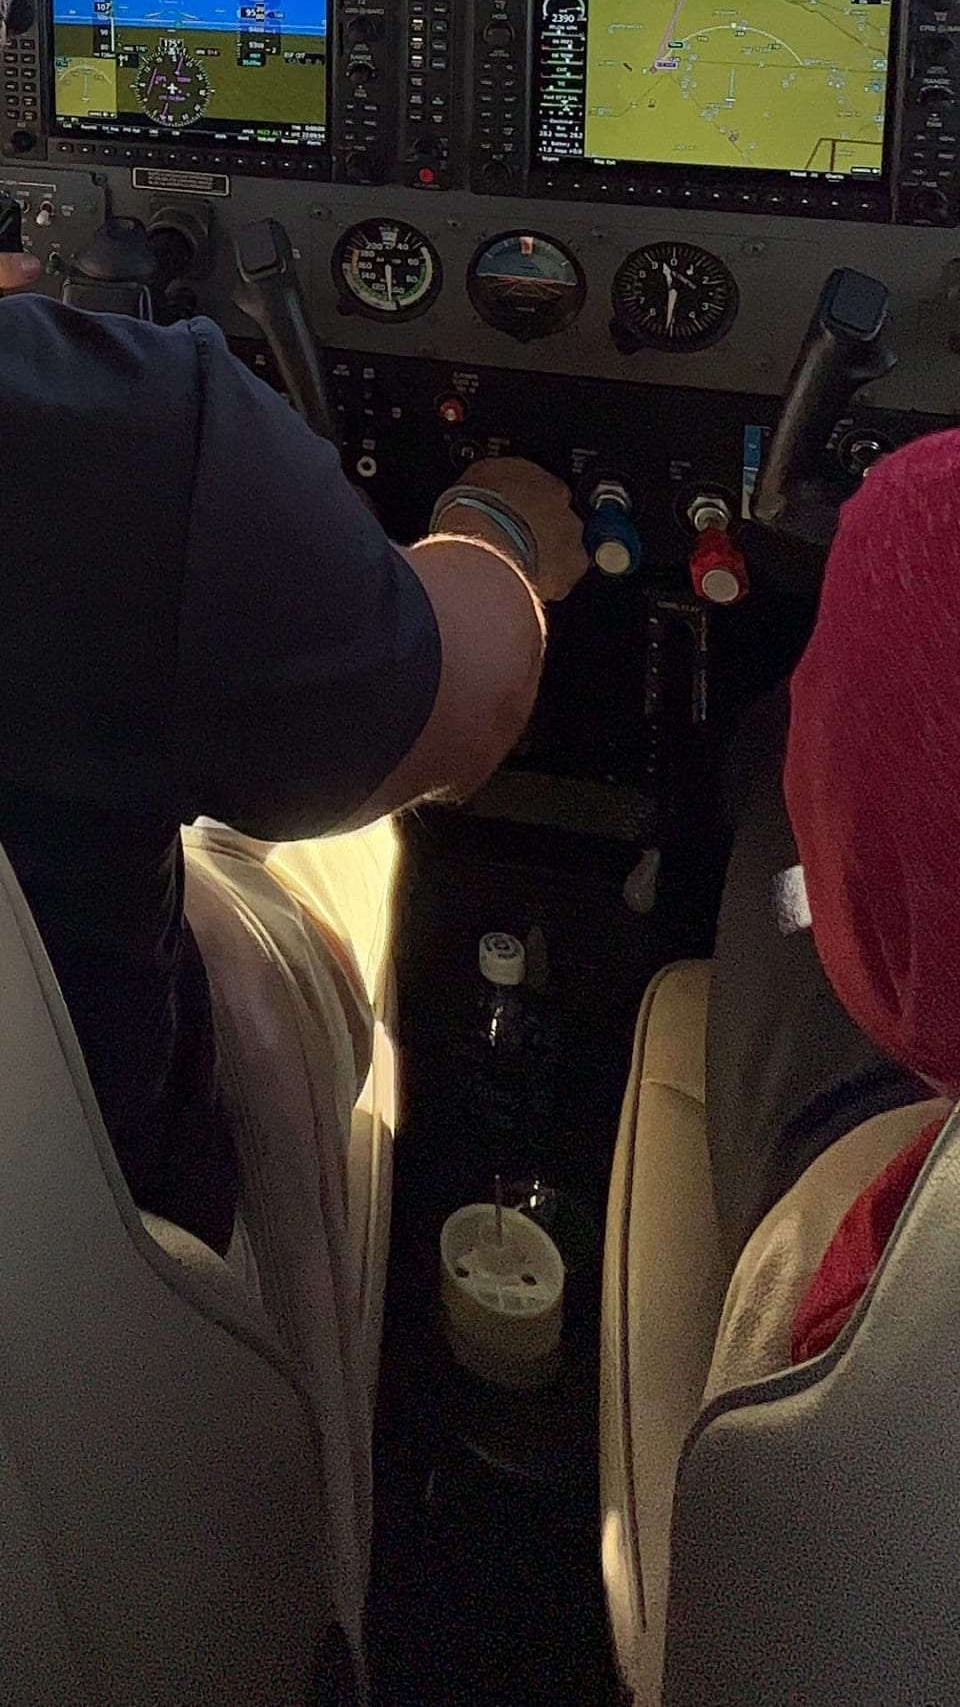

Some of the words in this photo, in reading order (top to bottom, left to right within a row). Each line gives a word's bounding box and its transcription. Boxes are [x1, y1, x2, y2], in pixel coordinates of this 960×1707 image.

[551, 14, 575, 23] 2390
[366, 242, 383, 251] 200
[396, 243, 409, 251] 40
